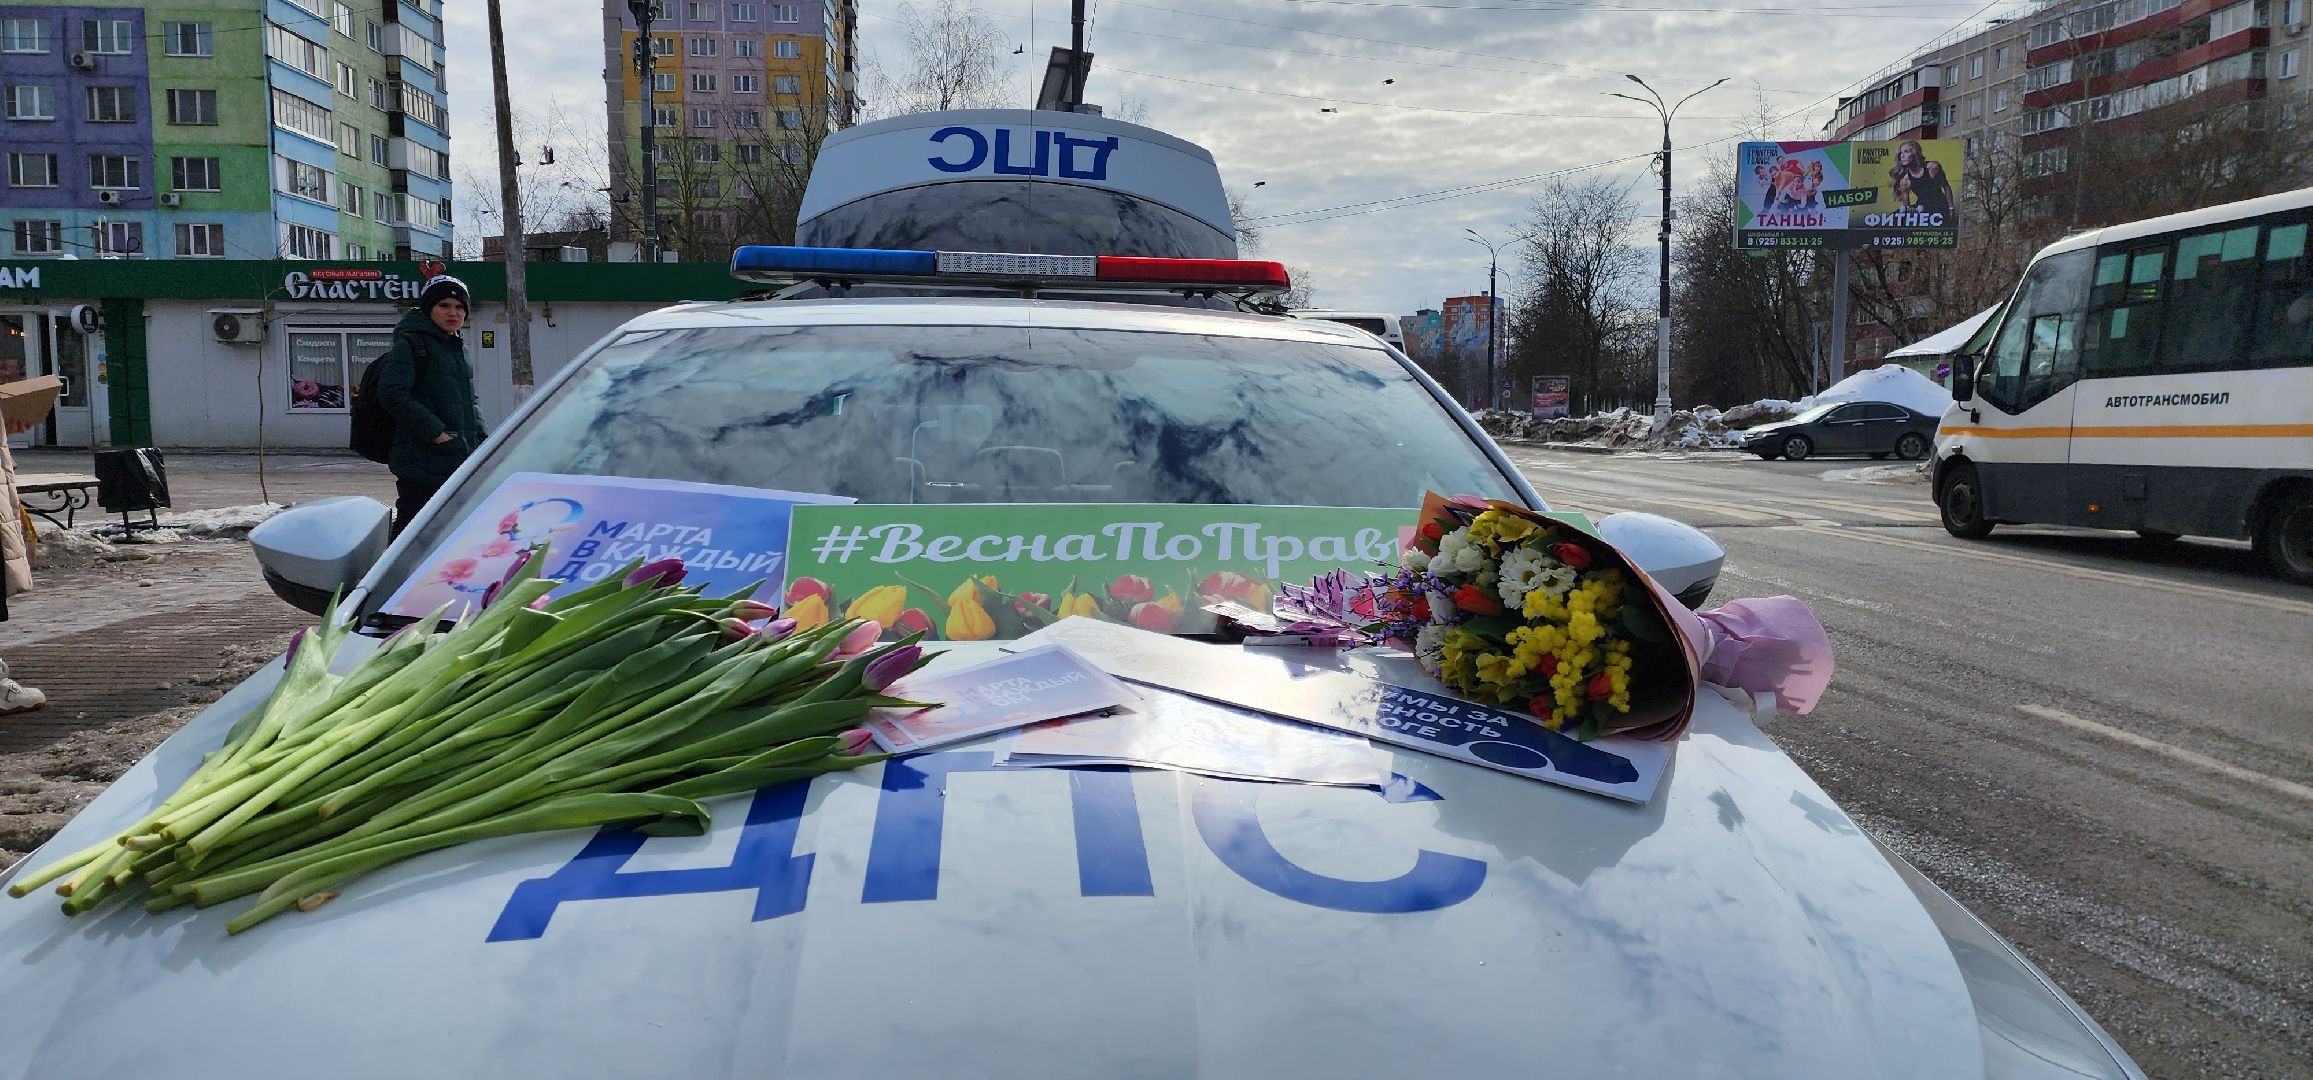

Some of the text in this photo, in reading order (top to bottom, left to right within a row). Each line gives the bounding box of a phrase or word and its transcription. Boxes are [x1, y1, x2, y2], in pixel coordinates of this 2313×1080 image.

[928, 126, 1119, 181] ДПС
[1862, 147, 1890, 157] PANTERA
[1828, 191, 1873, 206] НАБОР
[1757, 213, 1824, 228] ТАНЦЫ
[1864, 212, 1944, 227] ФИТНЕС
[1747, 237, 1823, 246] 8 (925) 833-11-25
[1873, 236, 1953, 246] 8 (925) 985-95-25
[284, 271, 420, 300] Сластён
[2105, 392, 2230, 408] АВТОТРАНСМОБИЛ
[587, 520, 713, 547] МАРТА
[570, 539, 783, 574] В КАЖДЫЙ
[549, 560, 626, 583] ДО
[1467, 710, 1509, 727] ЗА
[485, 750, 1488, 943] ДПС
